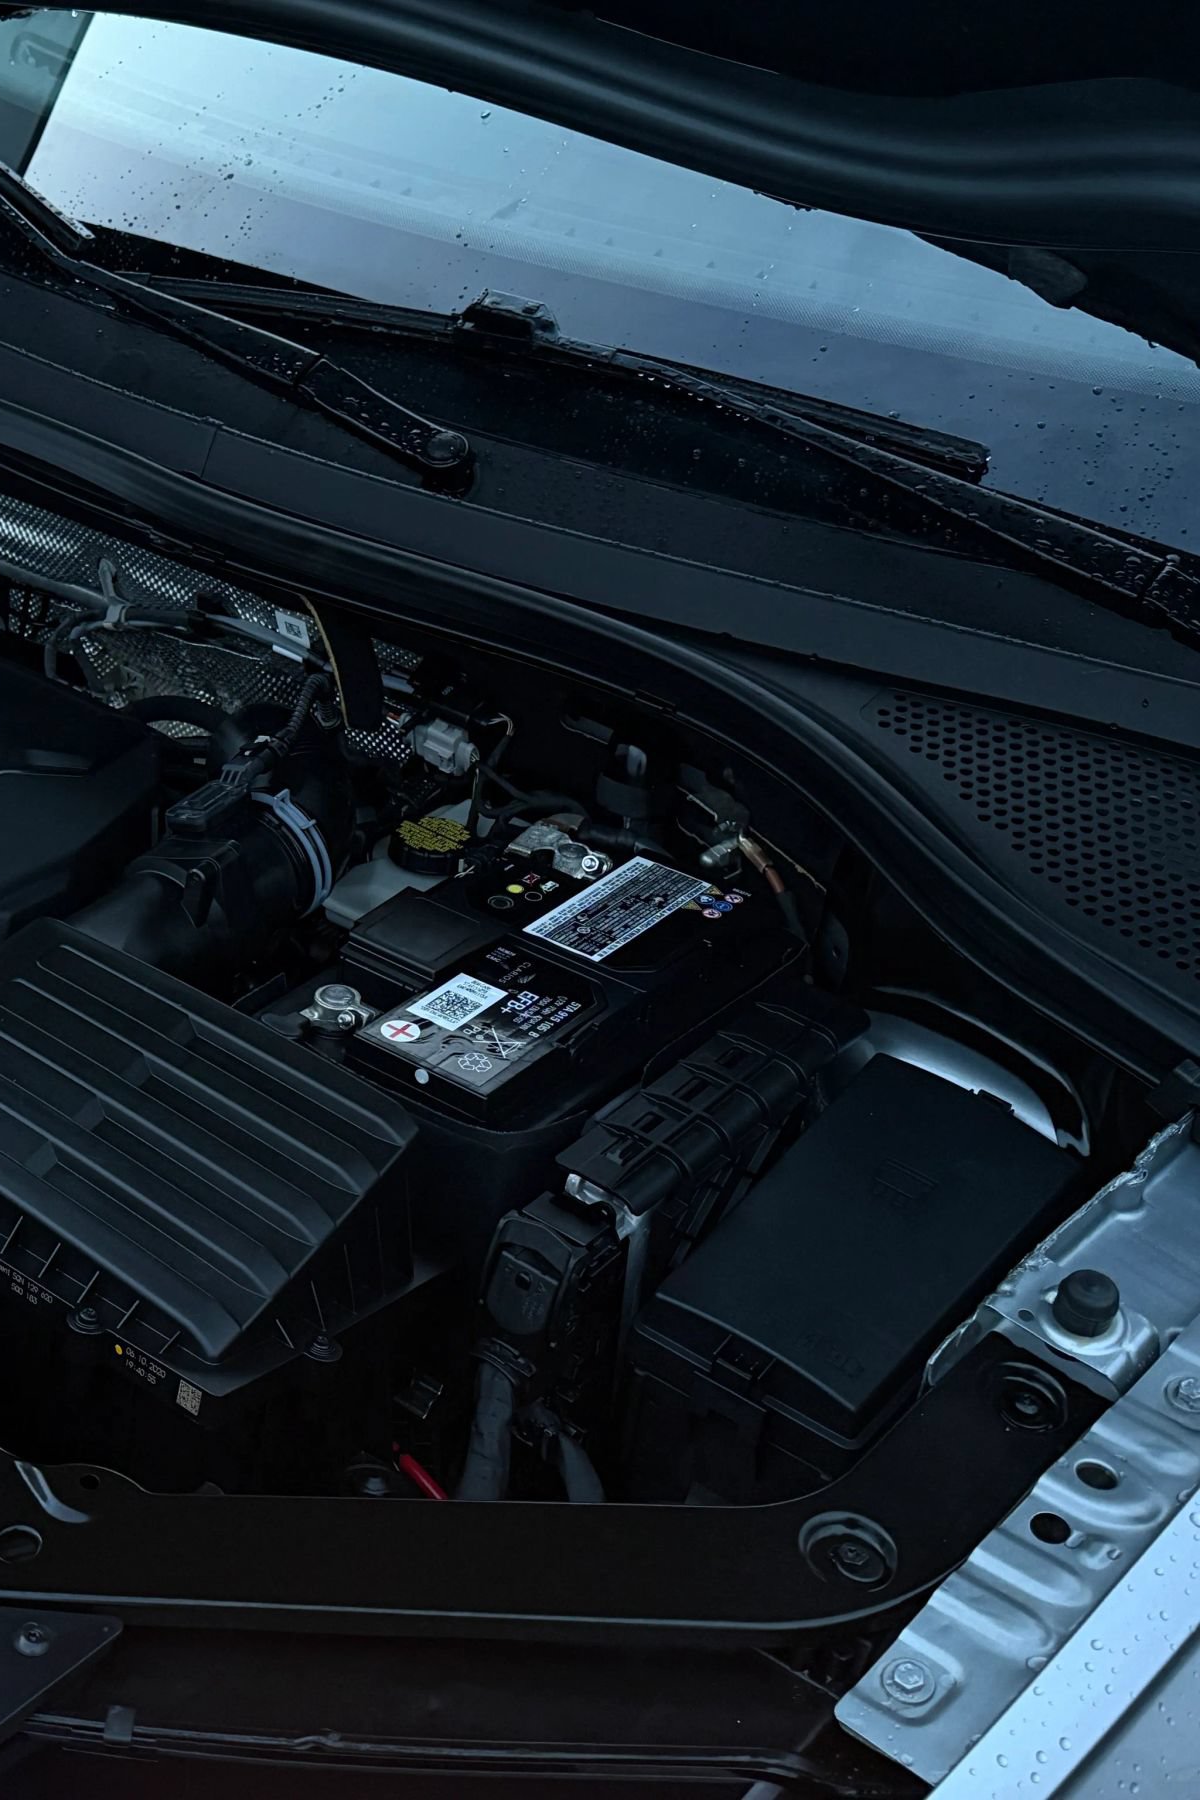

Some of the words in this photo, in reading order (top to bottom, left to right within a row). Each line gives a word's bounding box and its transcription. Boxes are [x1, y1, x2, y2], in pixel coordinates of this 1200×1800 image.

[498, 961, 532, 984] CLARIOS
[501, 990, 539, 1014] EFB+
[563, 1001, 581, 1013] 5TA
[550, 1010, 568, 1022] 915
[463, 1024, 482, 1035] Pb
[536, 1021, 554, 1033] 105
